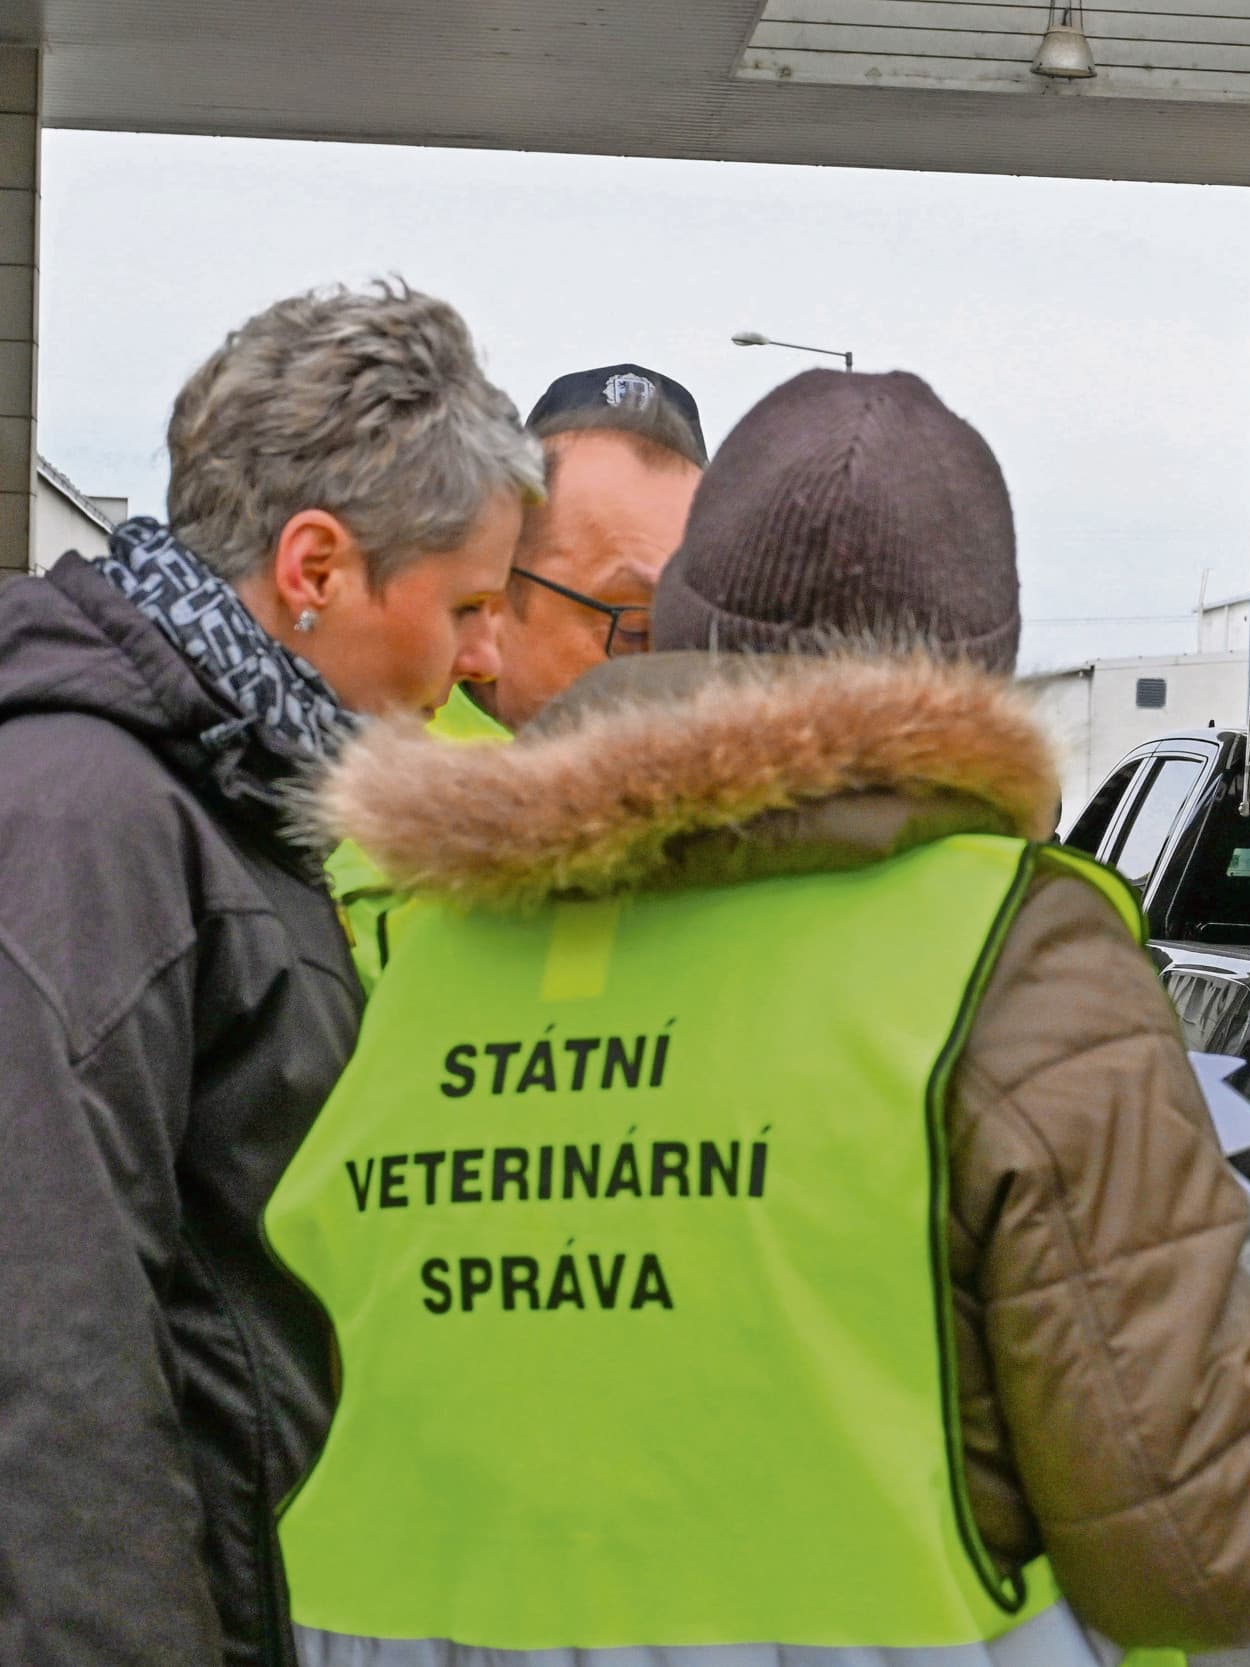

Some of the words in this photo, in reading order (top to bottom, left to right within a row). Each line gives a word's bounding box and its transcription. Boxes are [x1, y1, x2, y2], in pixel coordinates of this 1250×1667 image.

[441, 1018, 676, 1098] STÁTNÍ
[346, 1125, 771, 1212] VETERINÁRNÍ
[421, 1238, 673, 1315] SPRÁVA
